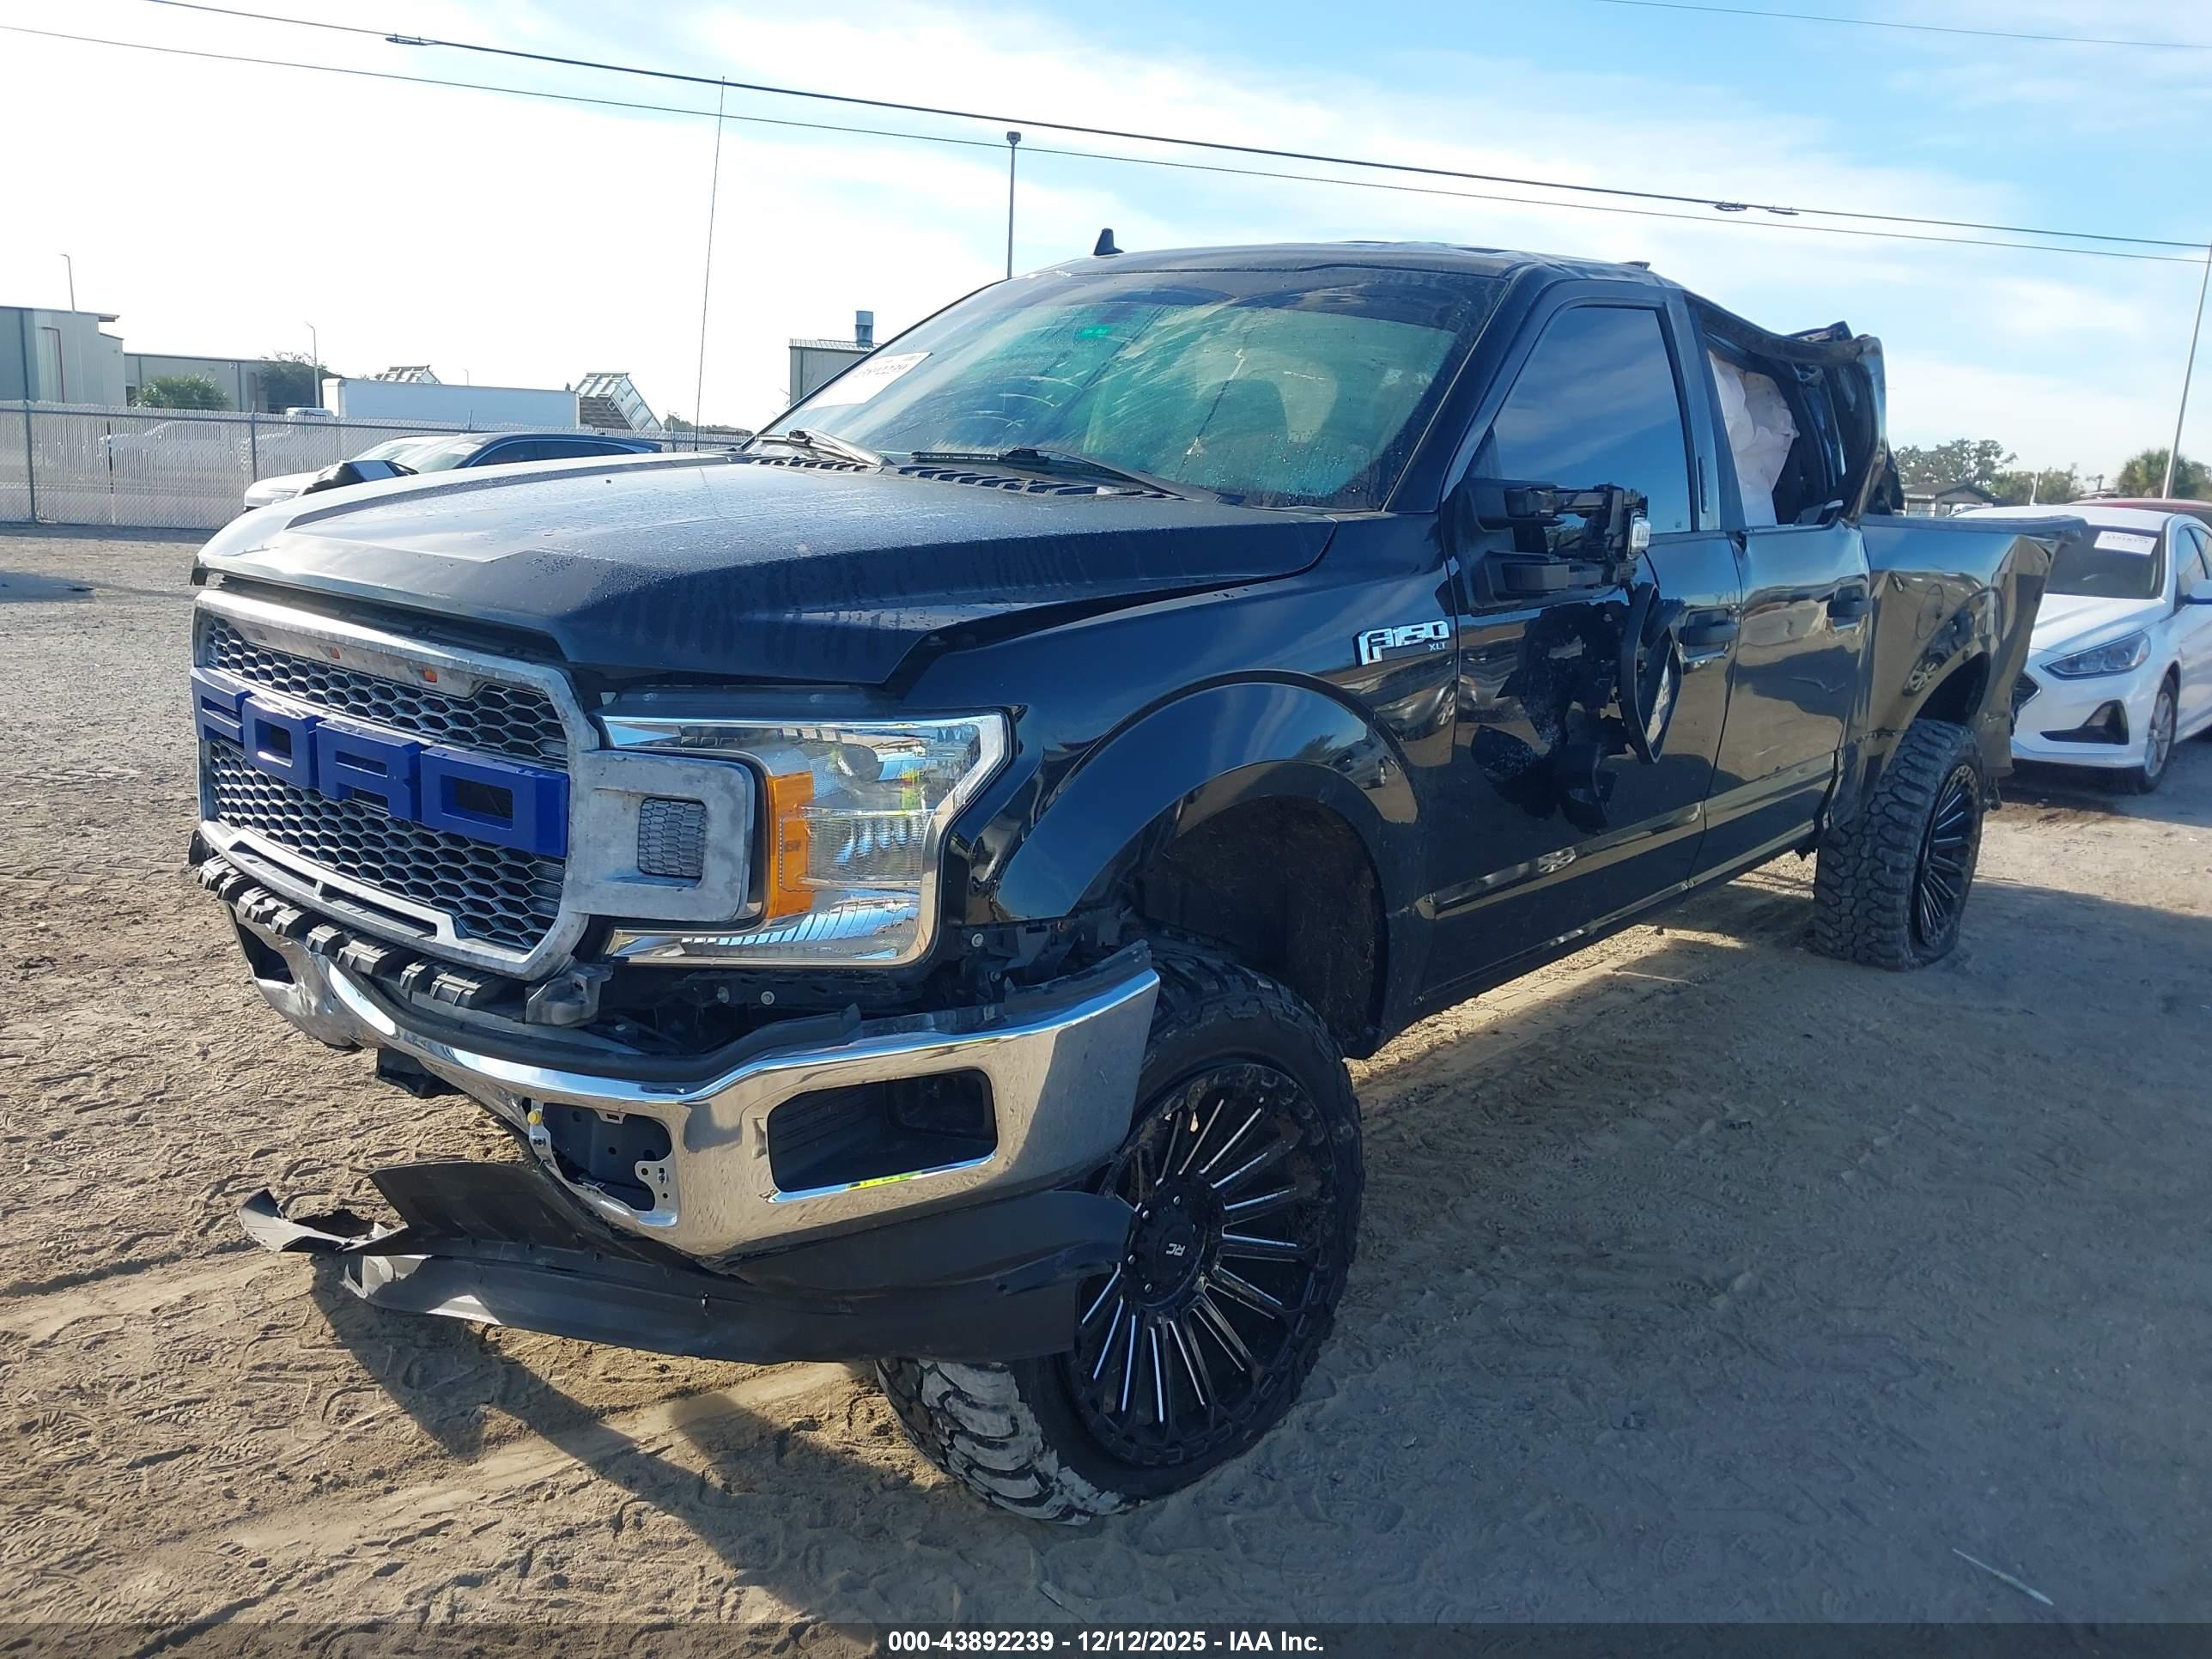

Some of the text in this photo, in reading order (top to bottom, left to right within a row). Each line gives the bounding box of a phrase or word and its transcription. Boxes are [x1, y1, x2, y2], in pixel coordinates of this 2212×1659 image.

[1428, 642, 1447, 652] XLT
[191, 667, 569, 858] FORD
[1166, 1243, 1186, 1256] RC
